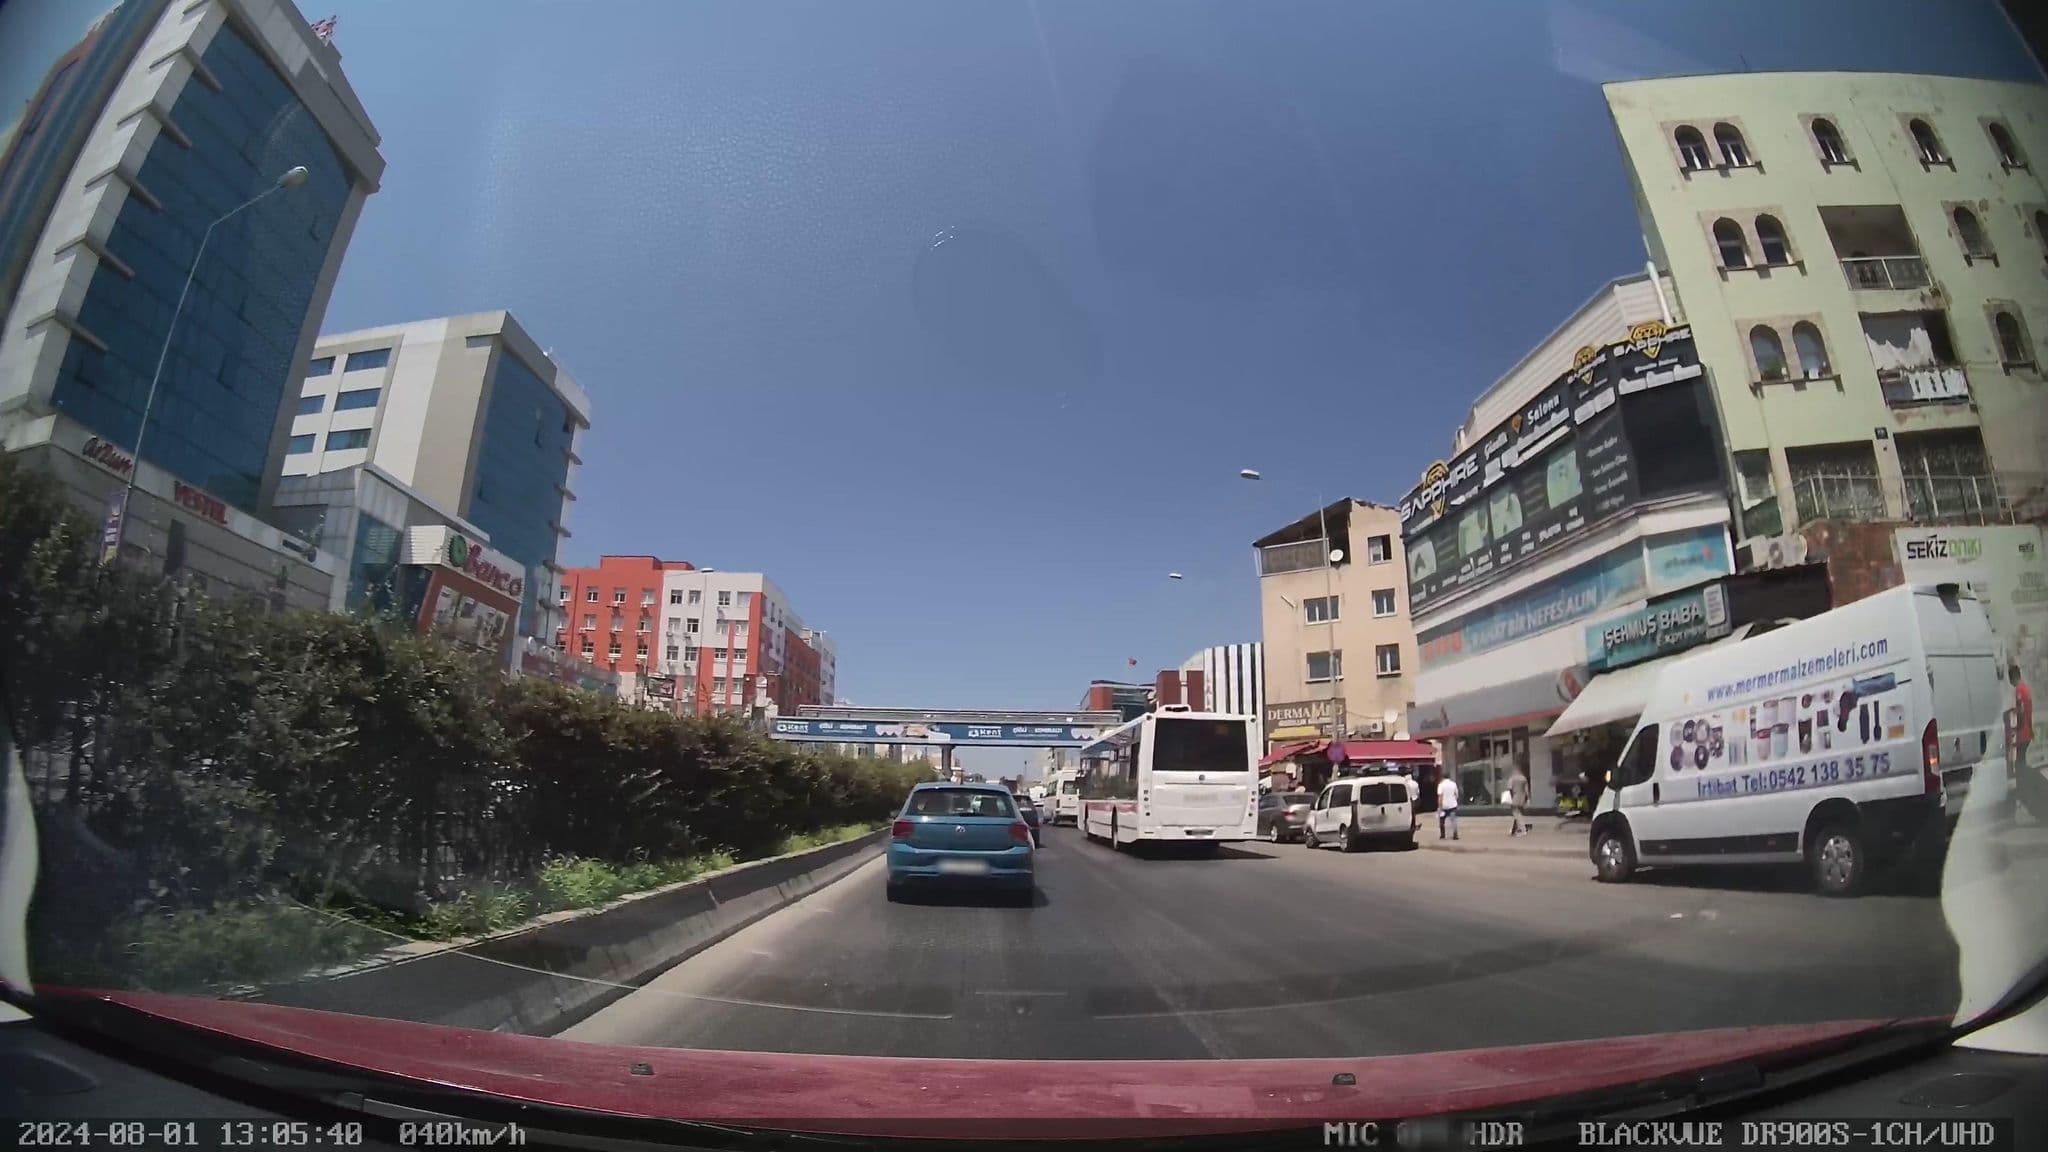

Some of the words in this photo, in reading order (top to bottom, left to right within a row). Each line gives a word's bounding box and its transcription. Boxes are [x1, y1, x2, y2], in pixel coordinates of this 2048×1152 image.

[1400, 452, 1480, 523] SAPPHIRE
[1659, 601, 1701, 630] BABA
[1707, 638, 1888, 702] www.mermermalzemeleri.com
[1811, 760, 1839, 782] 138
[1845, 757, 1864, 776] 35
[1870, 752, 1891, 774] 75
